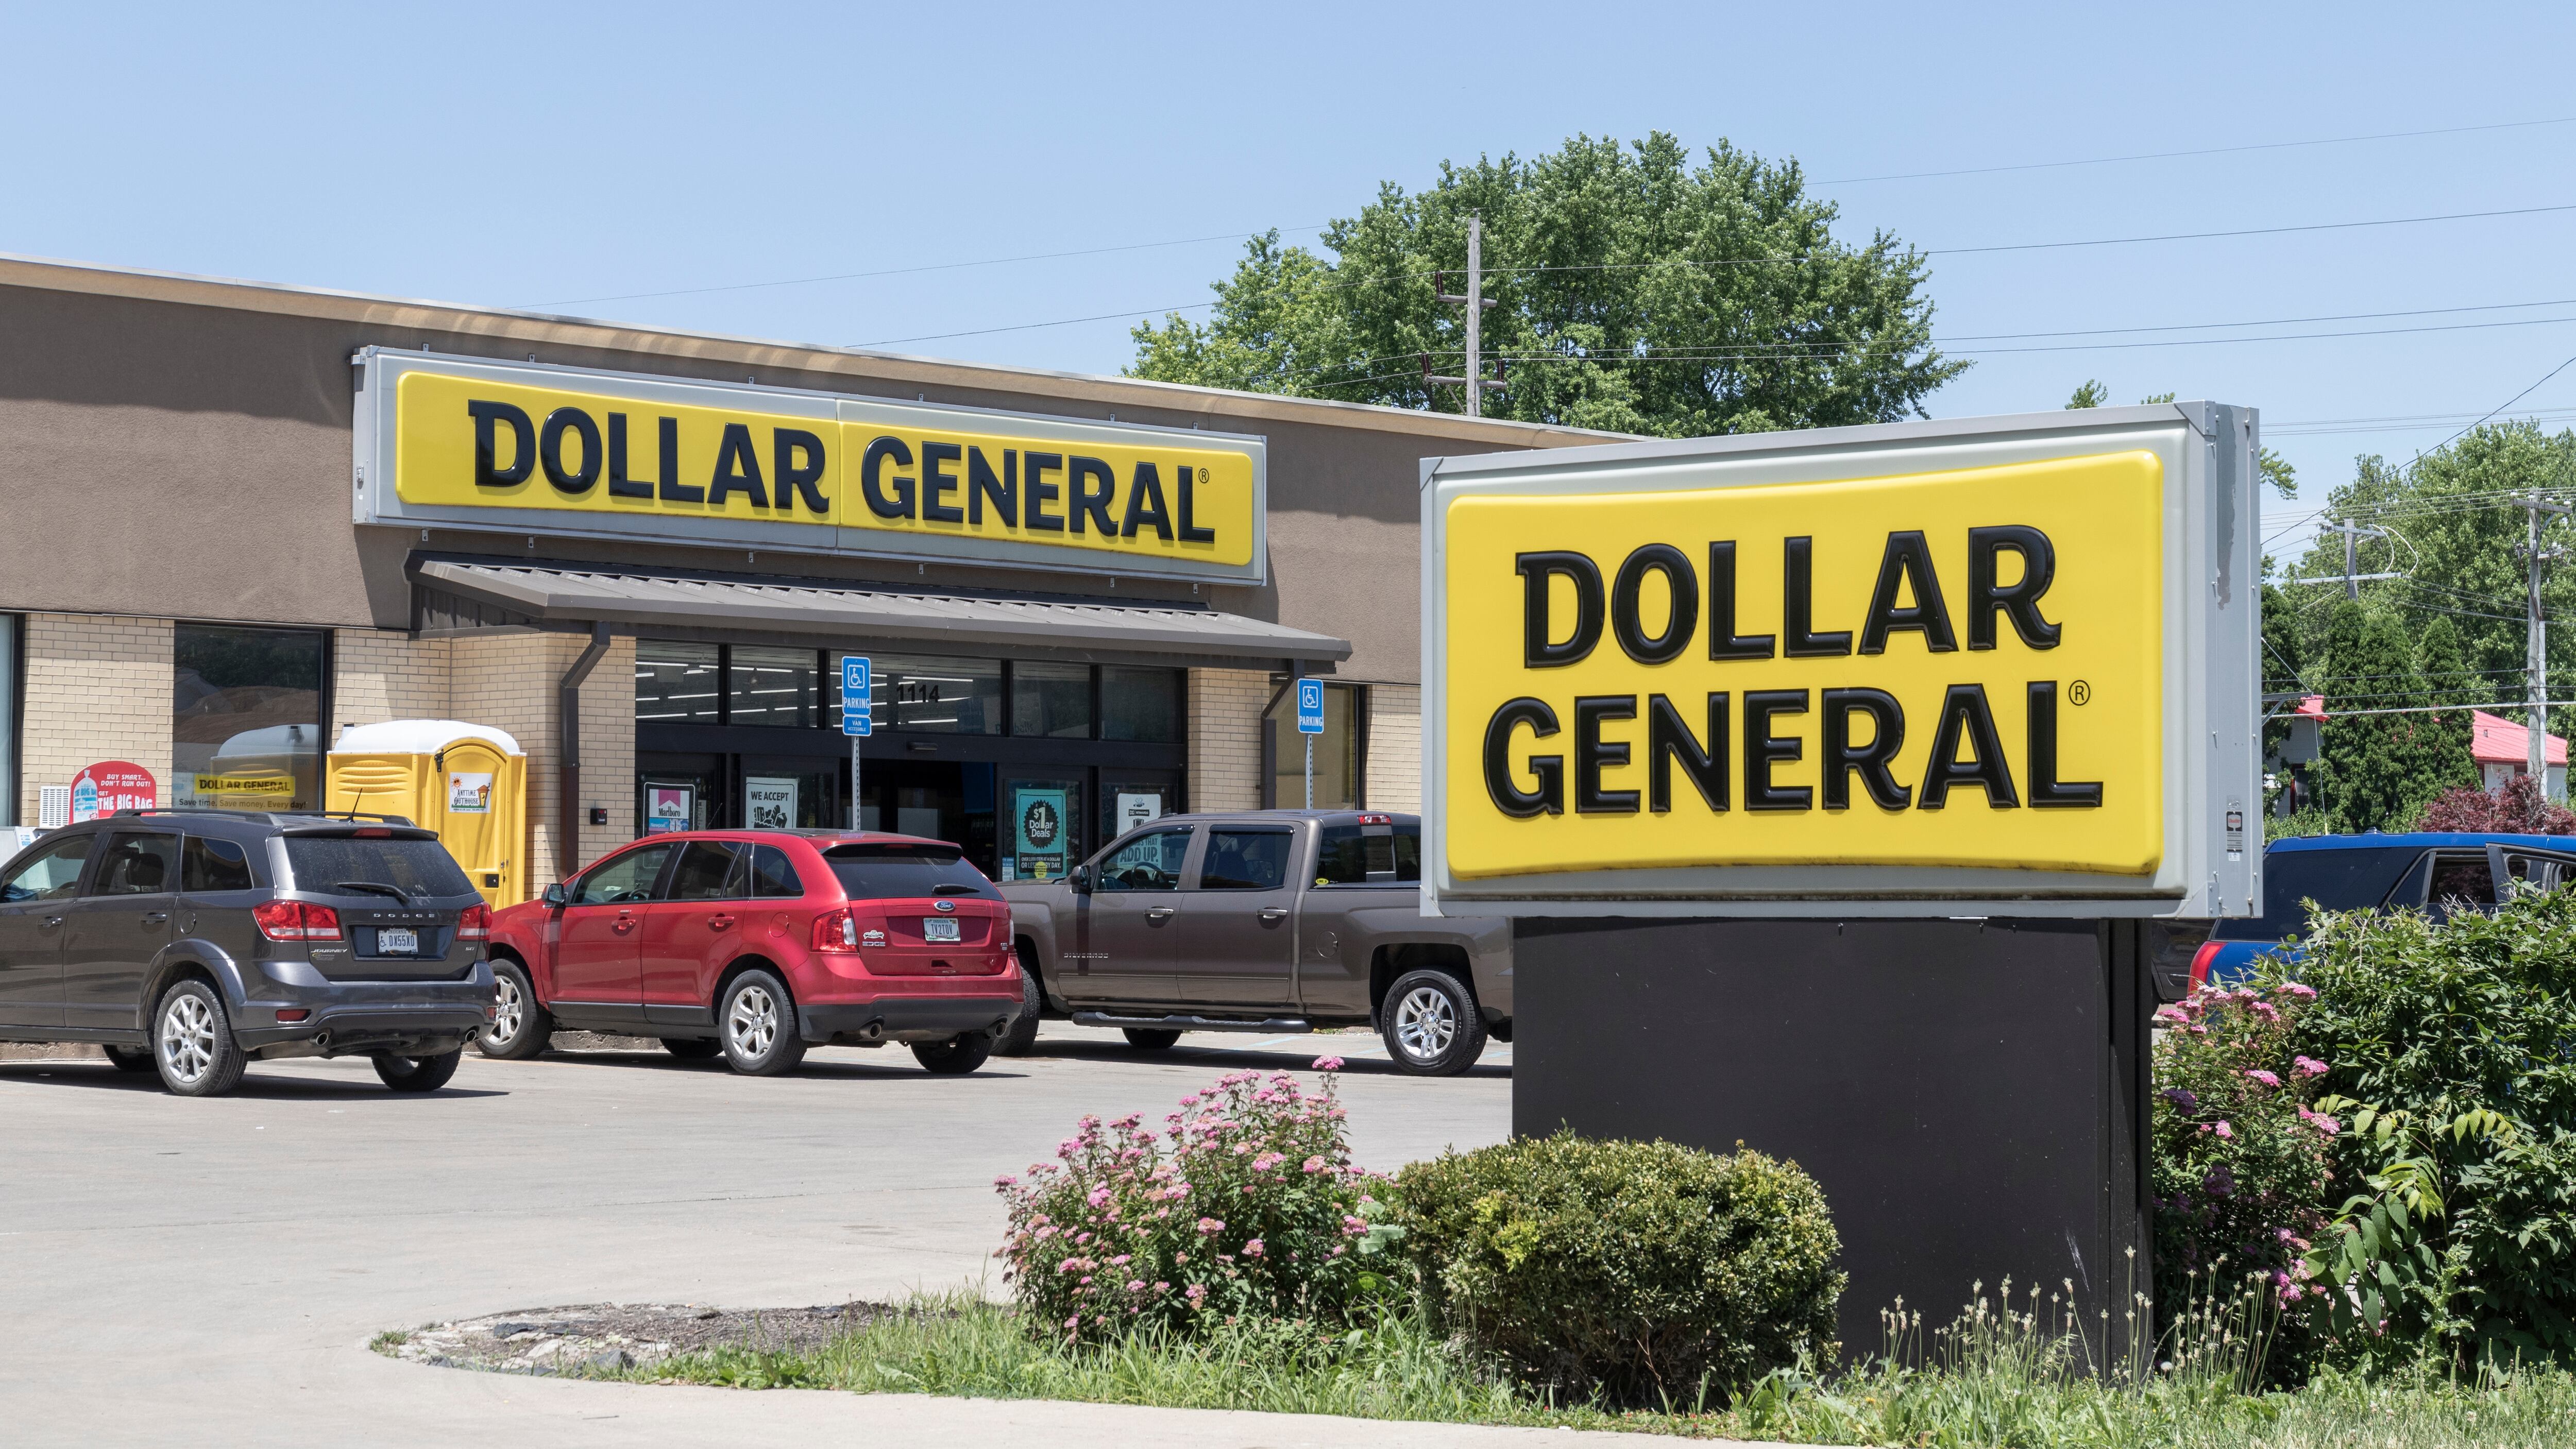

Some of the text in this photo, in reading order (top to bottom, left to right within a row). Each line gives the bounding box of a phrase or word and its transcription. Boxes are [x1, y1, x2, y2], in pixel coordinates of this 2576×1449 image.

[468, 399, 829, 514] DOLLAR
[1515, 524, 2062, 669] DOLLAR
[896, 684, 940, 703] 1114
[843, 697, 870, 709] PARKING
[1299, 715, 1323, 727] PARKING
[199, 779, 290, 791] DOLLAR GENERAL
[98, 795, 114, 810] THE
[117, 794, 132, 810] BIG
[135, 795, 152, 809] BAG
[751, 791, 789, 801] WE ACCEPT
[267, 800, 289, 809] Every
[290, 801, 306, 809] day!
[658, 806, 681, 817] Marlboro
[1031, 828, 1050, 838] Deals
[1145, 837, 1158, 846] THAT
[1120, 846, 1159, 862] ADD UP.
